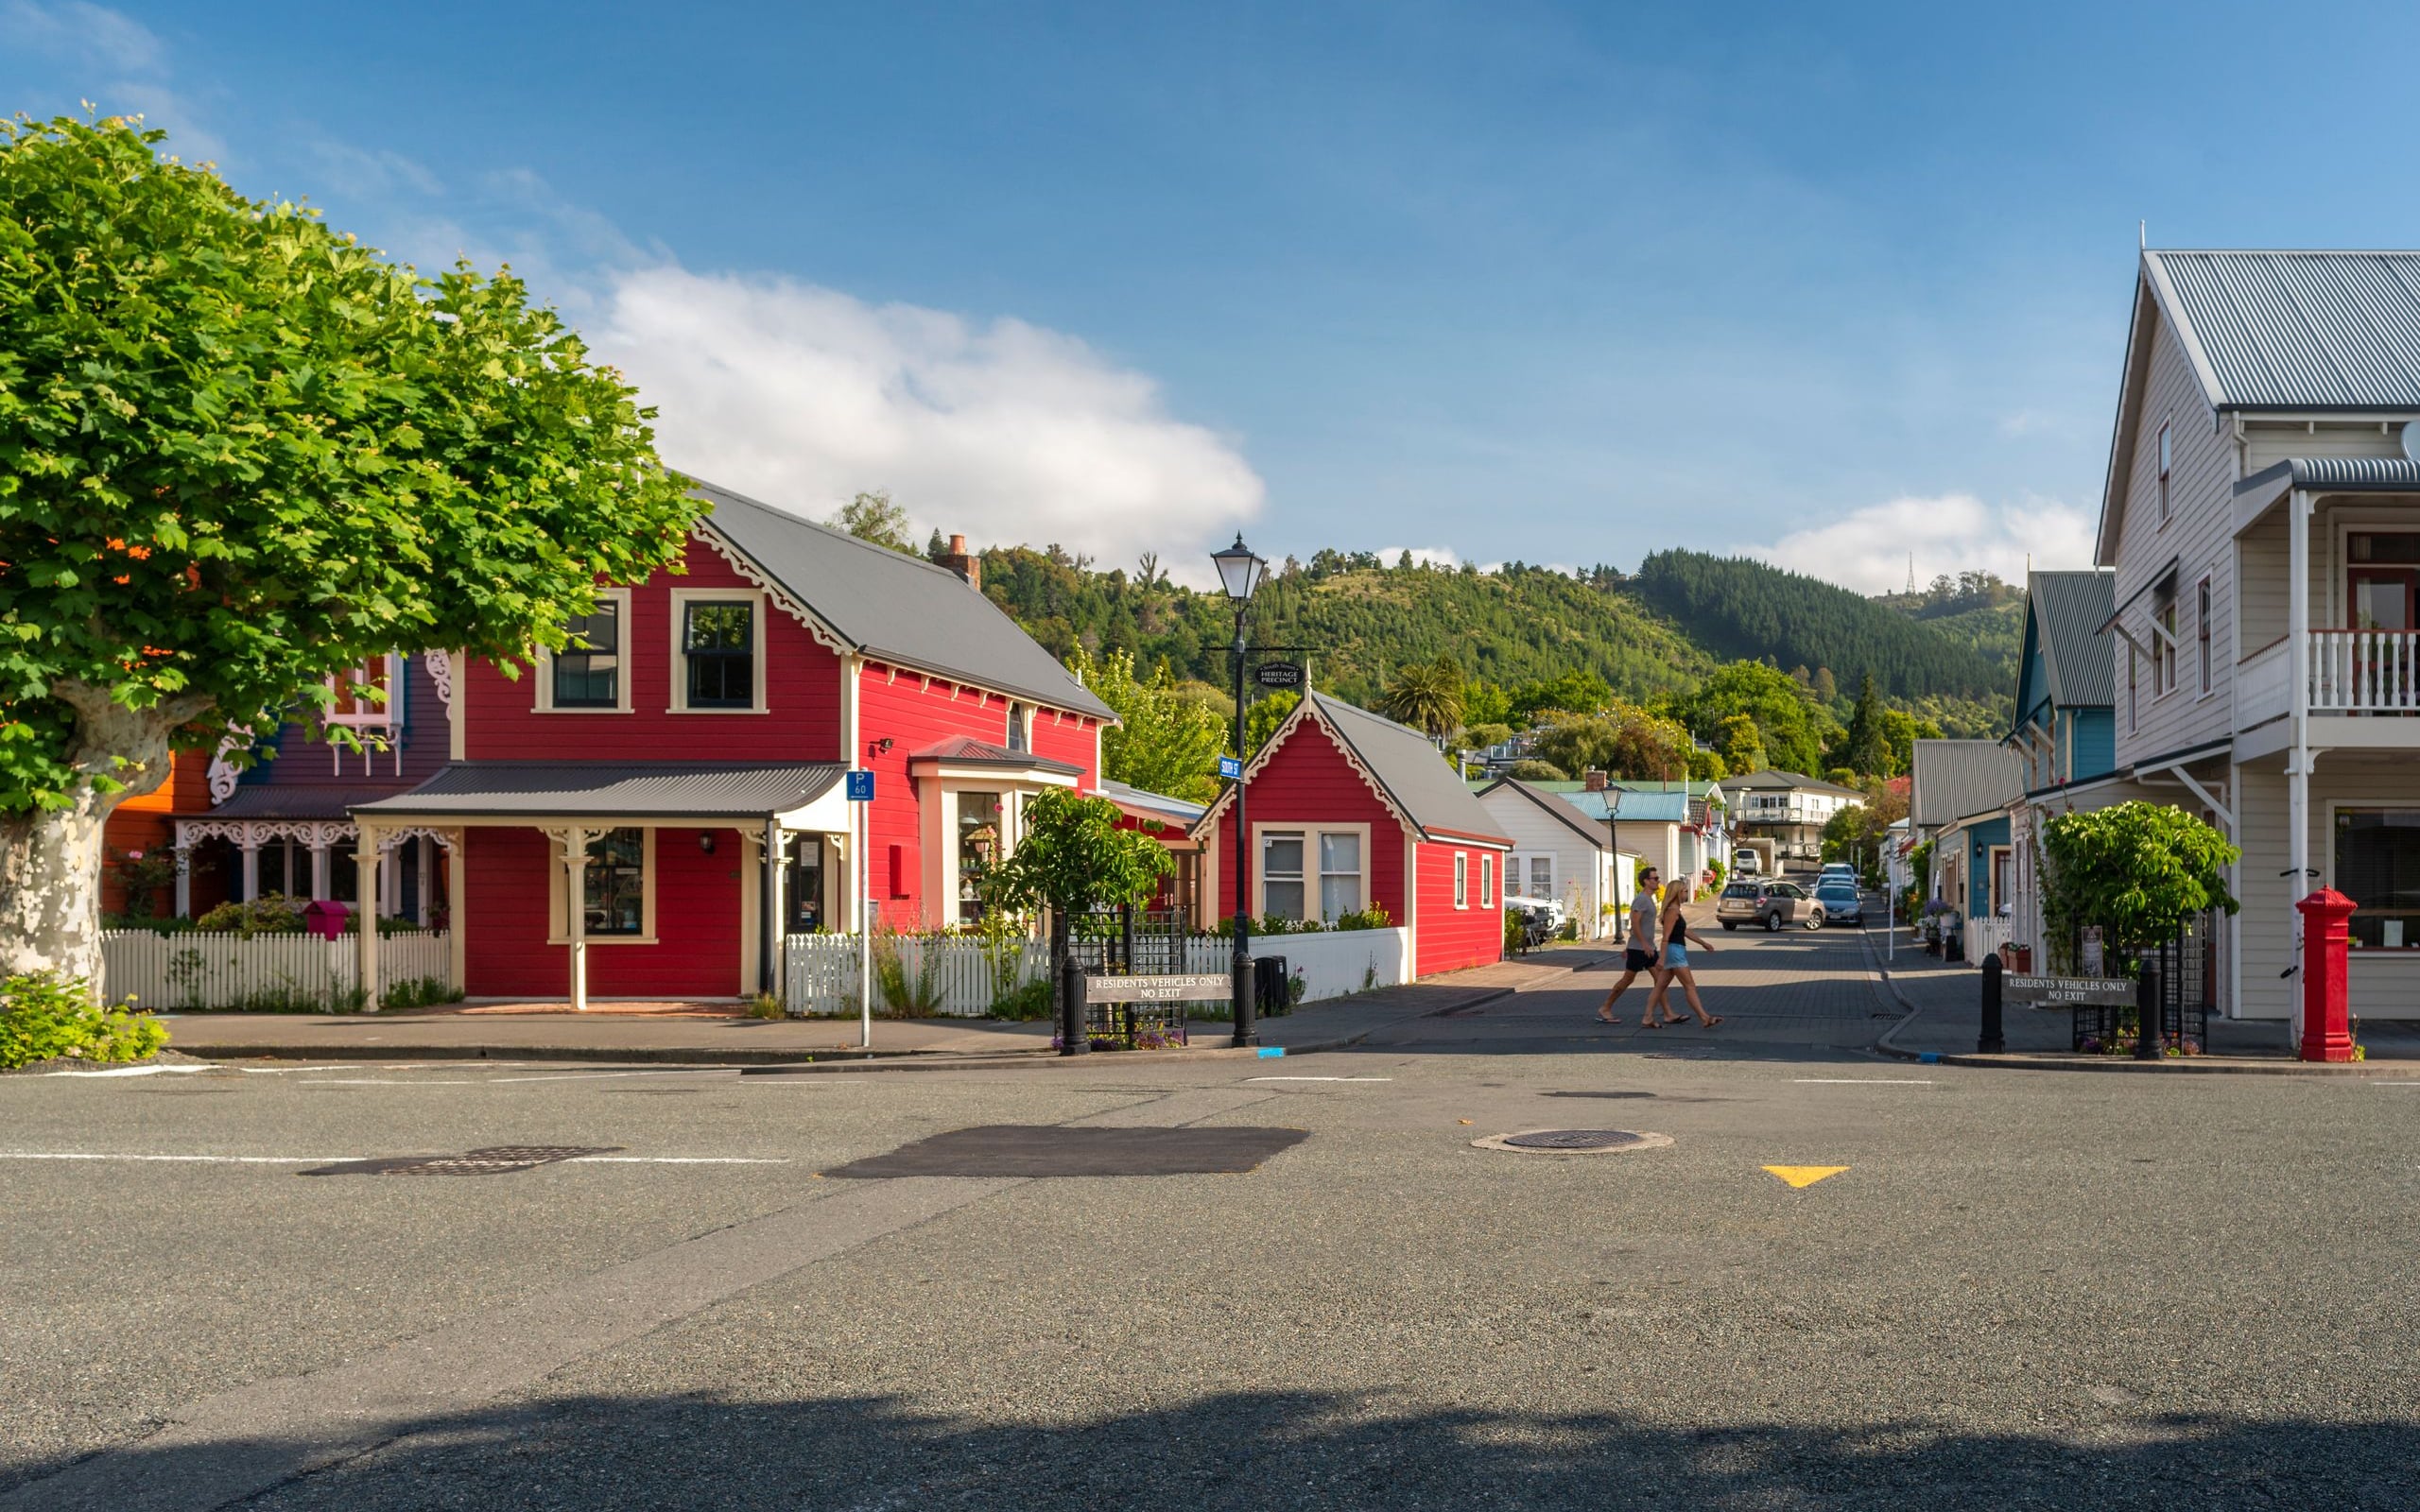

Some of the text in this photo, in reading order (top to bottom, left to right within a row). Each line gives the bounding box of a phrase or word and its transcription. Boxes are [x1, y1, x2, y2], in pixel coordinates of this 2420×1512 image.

[856, 773, 865, 784] P
[855, 785, 866, 794] 60
[1096, 976, 1224, 988] RESIDENTS VEHICLES ONLY
[2009, 978, 2127, 991] RESIDENTS VEHICLES ONLY
[1141, 988, 1182, 998] NO EXIT
[2048, 990, 2086, 1002] NO EXIT
